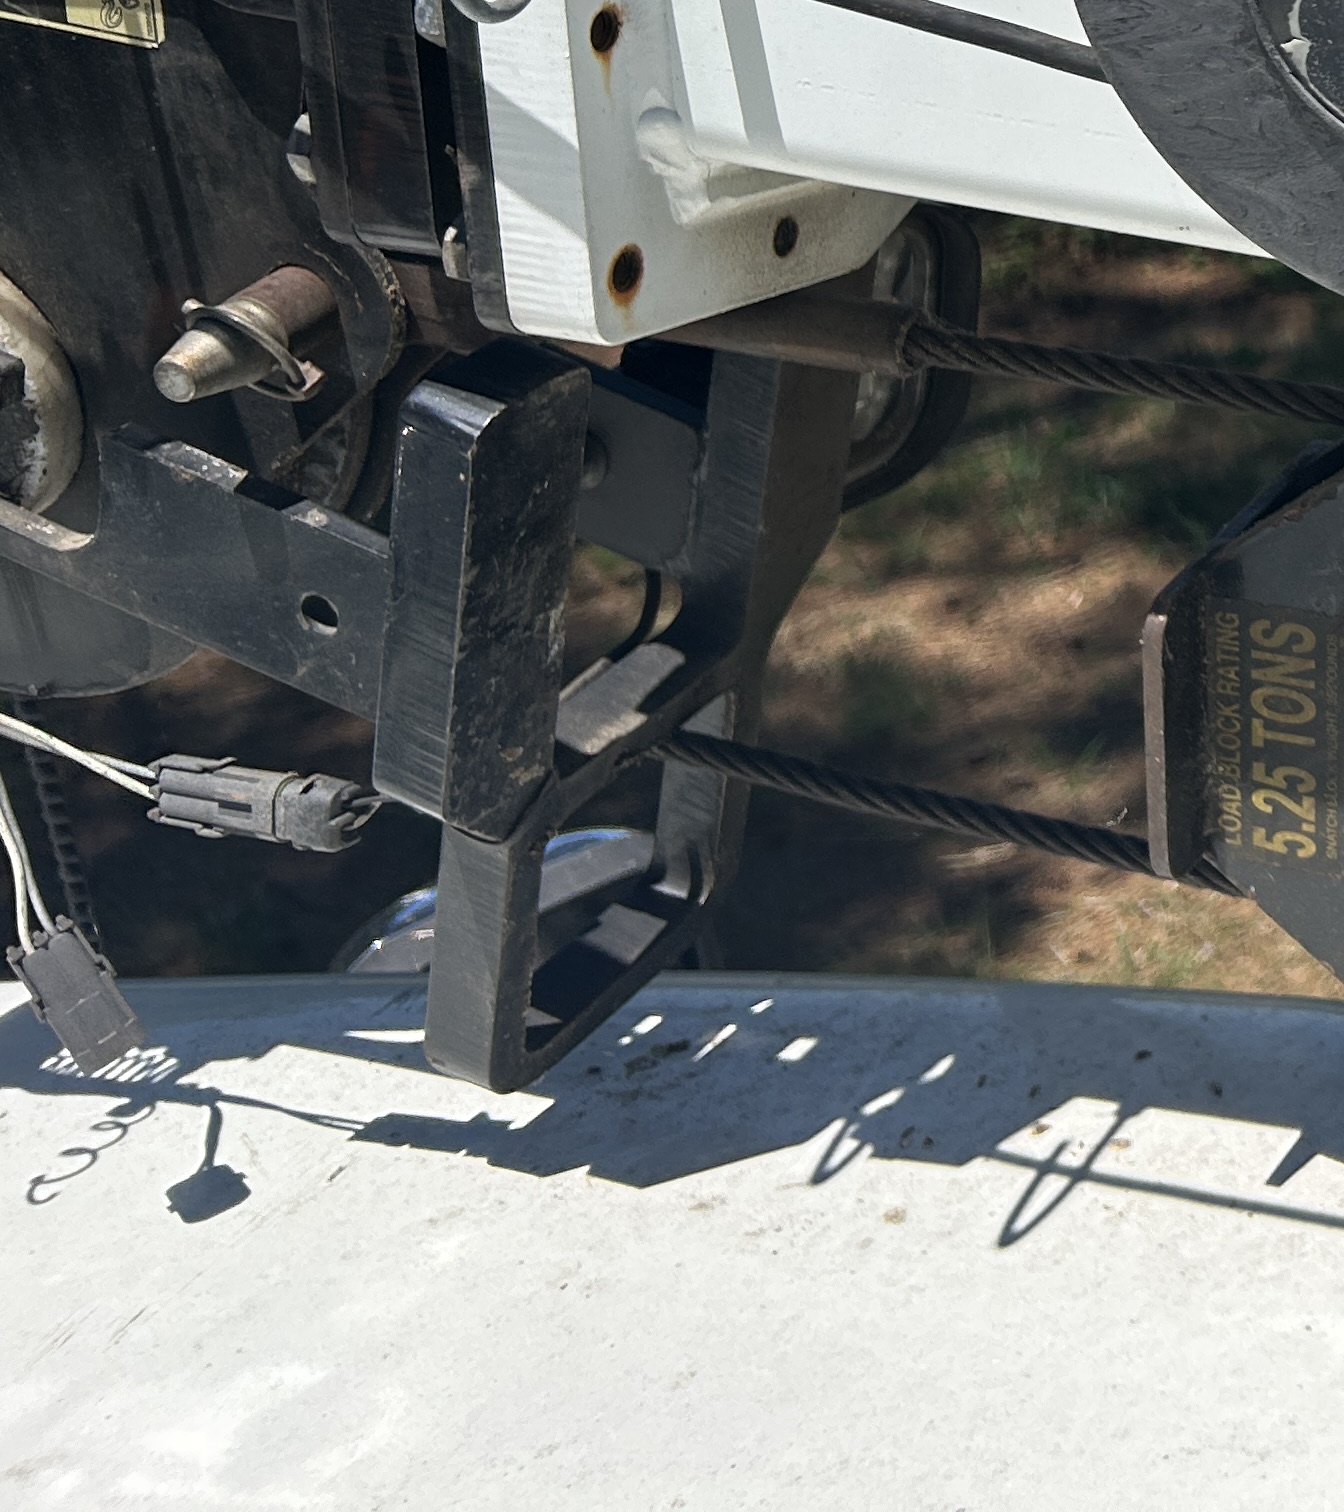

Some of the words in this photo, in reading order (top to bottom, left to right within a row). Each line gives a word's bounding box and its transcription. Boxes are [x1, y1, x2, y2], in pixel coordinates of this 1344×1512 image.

[1215, 610, 1240, 697] RATING
[1247, 618, 1318, 749] TONS
[1216, 700, 1242, 780] BLOCK
[1218, 785, 1243, 847] LOAD
[1251, 760, 1317, 859] 5.25
